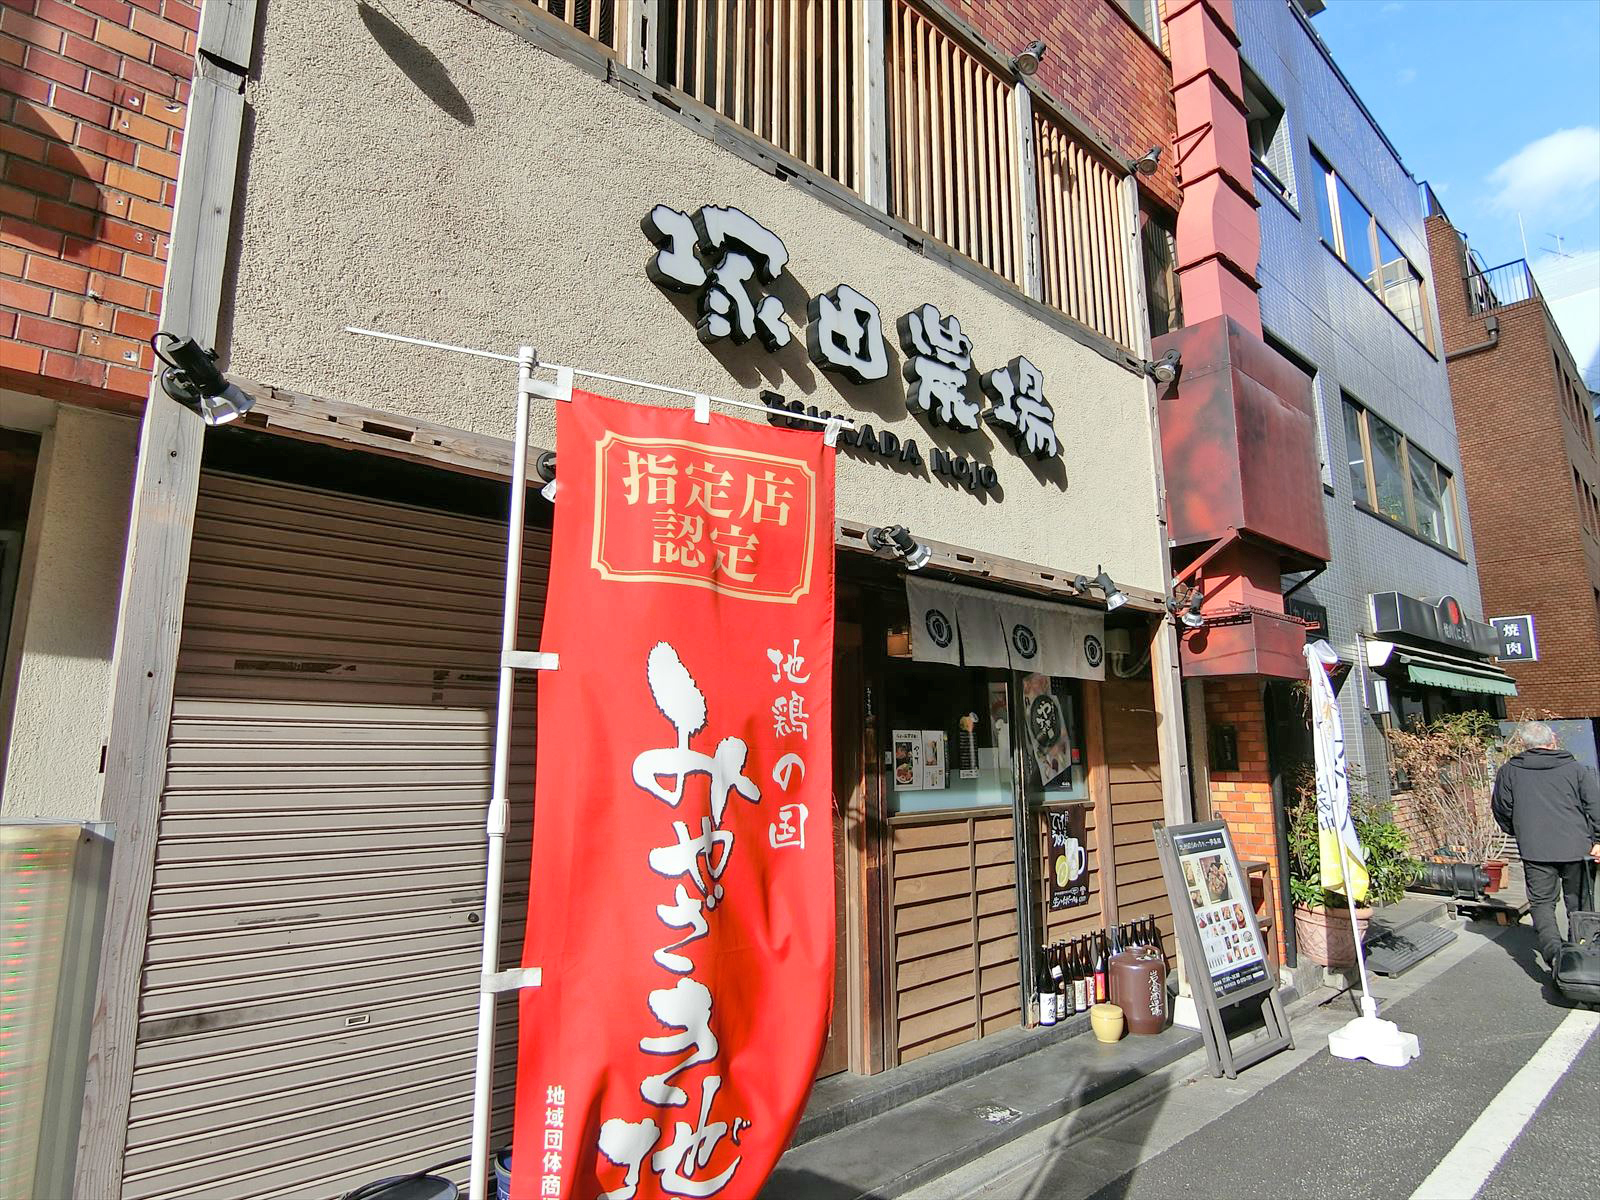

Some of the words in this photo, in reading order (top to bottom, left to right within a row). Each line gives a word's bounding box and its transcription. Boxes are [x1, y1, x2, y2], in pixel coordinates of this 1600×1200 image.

[640, 203, 1058, 460] 塚田農場
[622, 450, 795, 528] 指定店
[930, 448, 998, 490] NOJO
[651, 509, 760, 584] 認定
[1502, 623, 1522, 656] 焼肉
[766, 638, 810, 851] 地鶏の国
[597, 640, 761, 1200] みやざき地
[541, 1085, 565, 1200] 地域団体商
